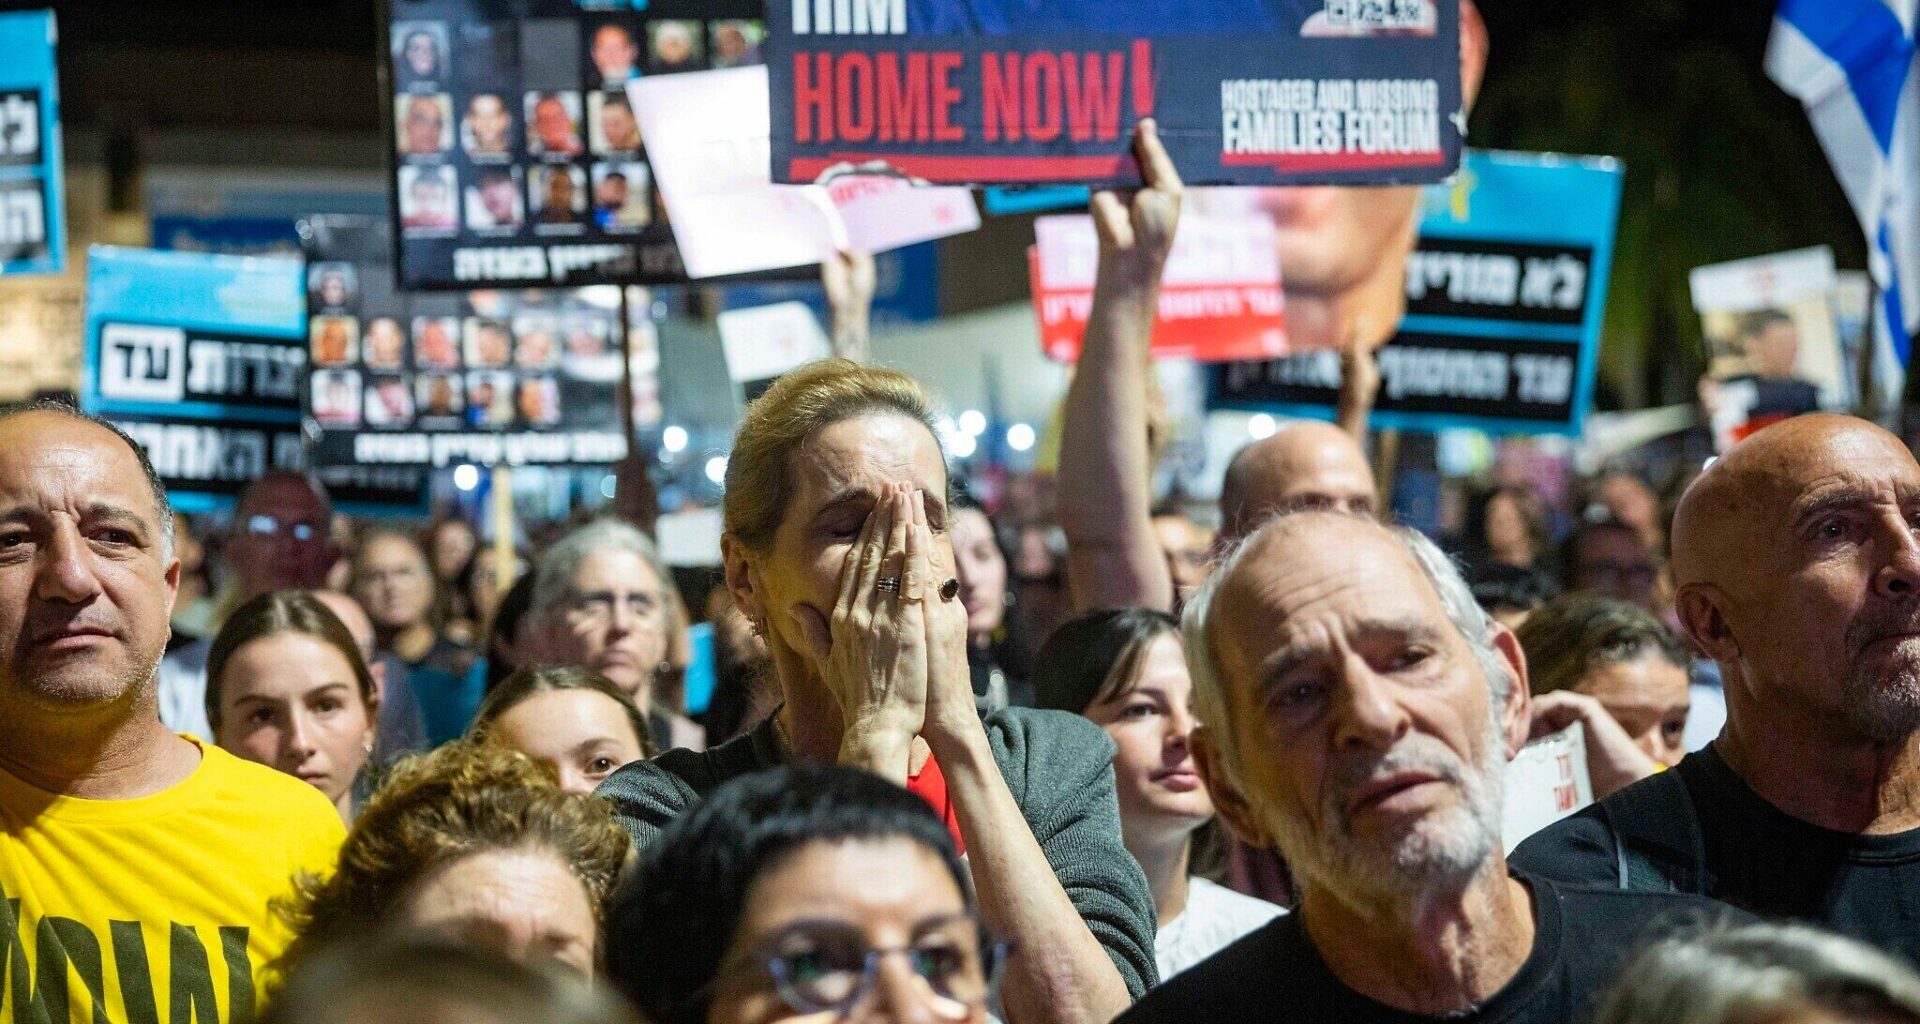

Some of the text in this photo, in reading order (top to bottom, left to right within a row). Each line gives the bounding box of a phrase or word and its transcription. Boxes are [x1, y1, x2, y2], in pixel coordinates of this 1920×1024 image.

[793, 38, 1152, 143] HOME NOW!
[1221, 79, 1439, 111] HOSTAGES AND MISSING
[1223, 110, 1441, 154] FAMILIES FORUM
[1519, 253, 1588, 311] לא
[112, 342, 170, 381] עד
